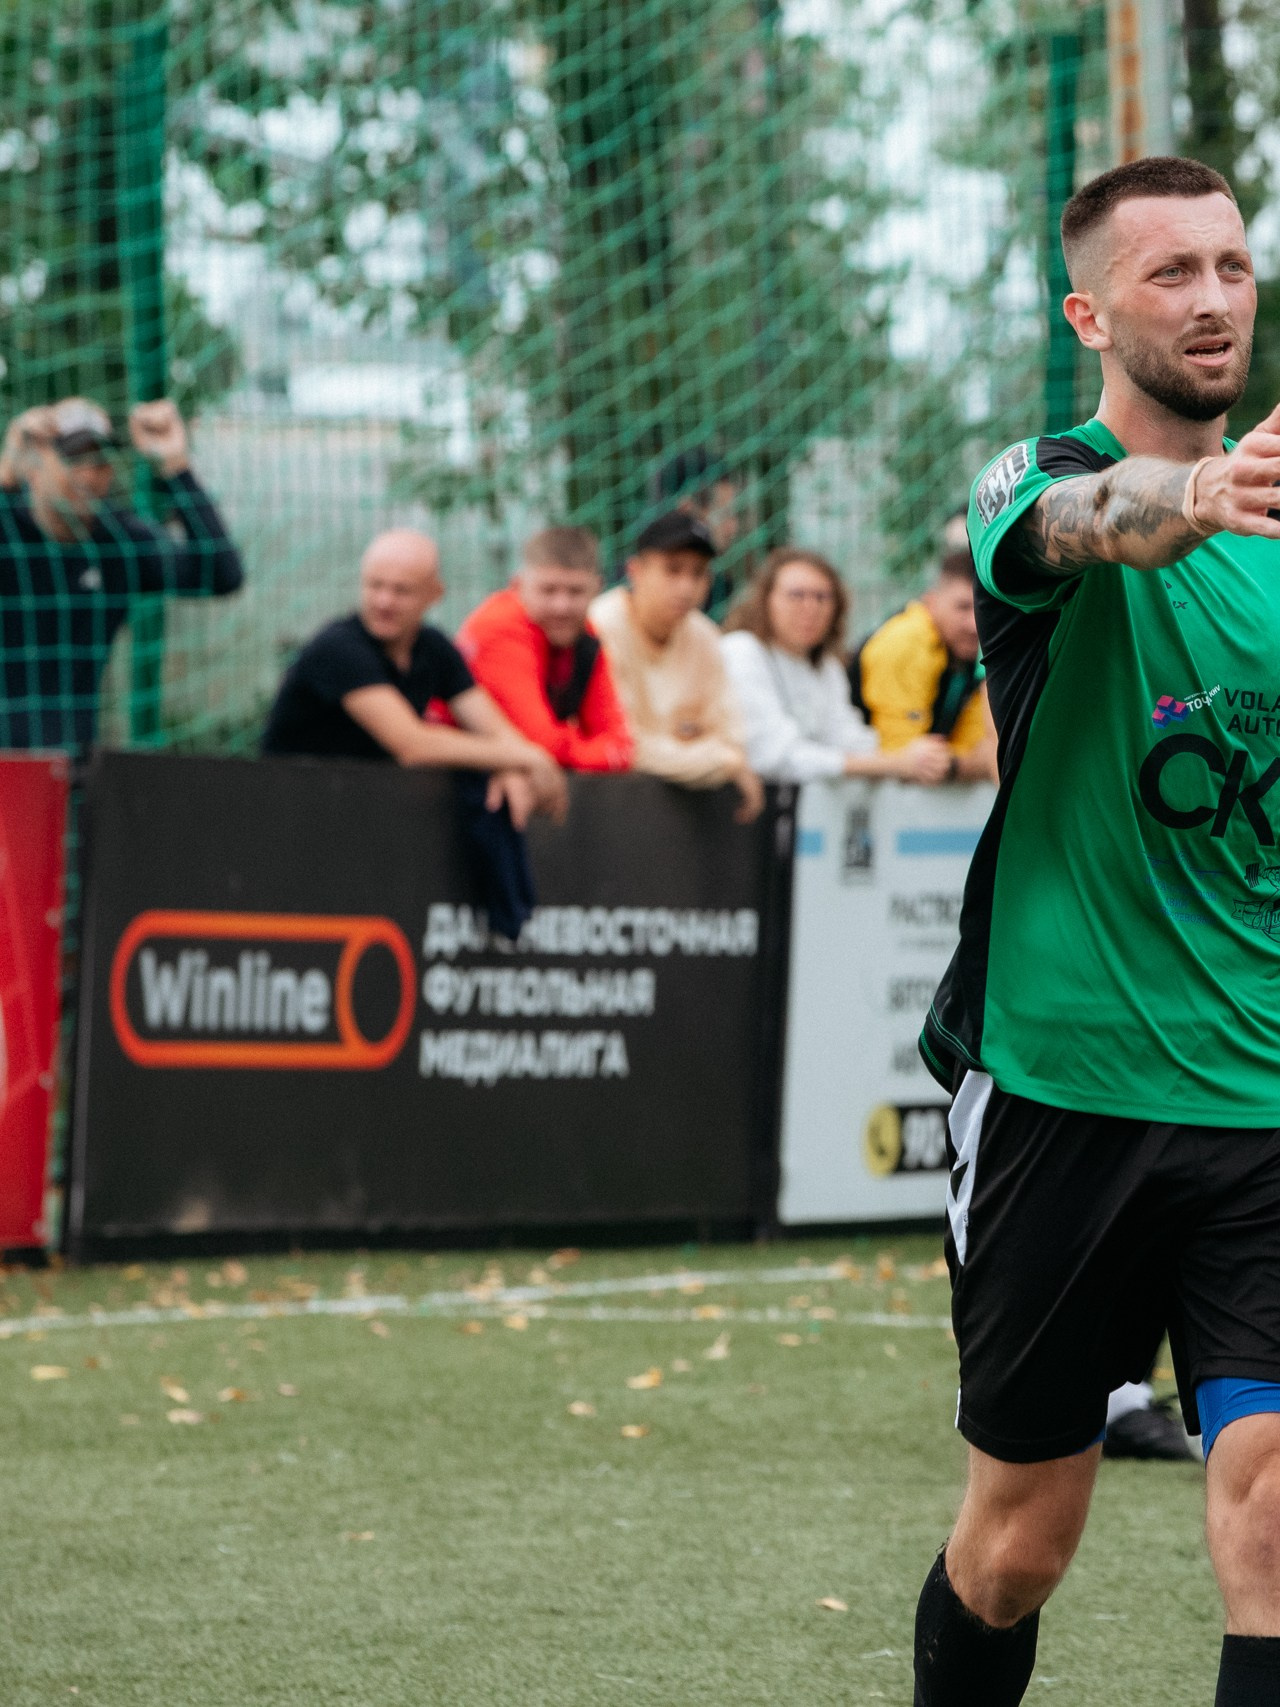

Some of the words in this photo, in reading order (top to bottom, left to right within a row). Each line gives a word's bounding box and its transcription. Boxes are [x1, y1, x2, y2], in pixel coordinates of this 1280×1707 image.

[139, 948, 332, 1034] Winline
[422, 961, 656, 1018] ФУТБОЛЬНАЯ
[418, 1028, 631, 1088] МЕДИАЛИГА
